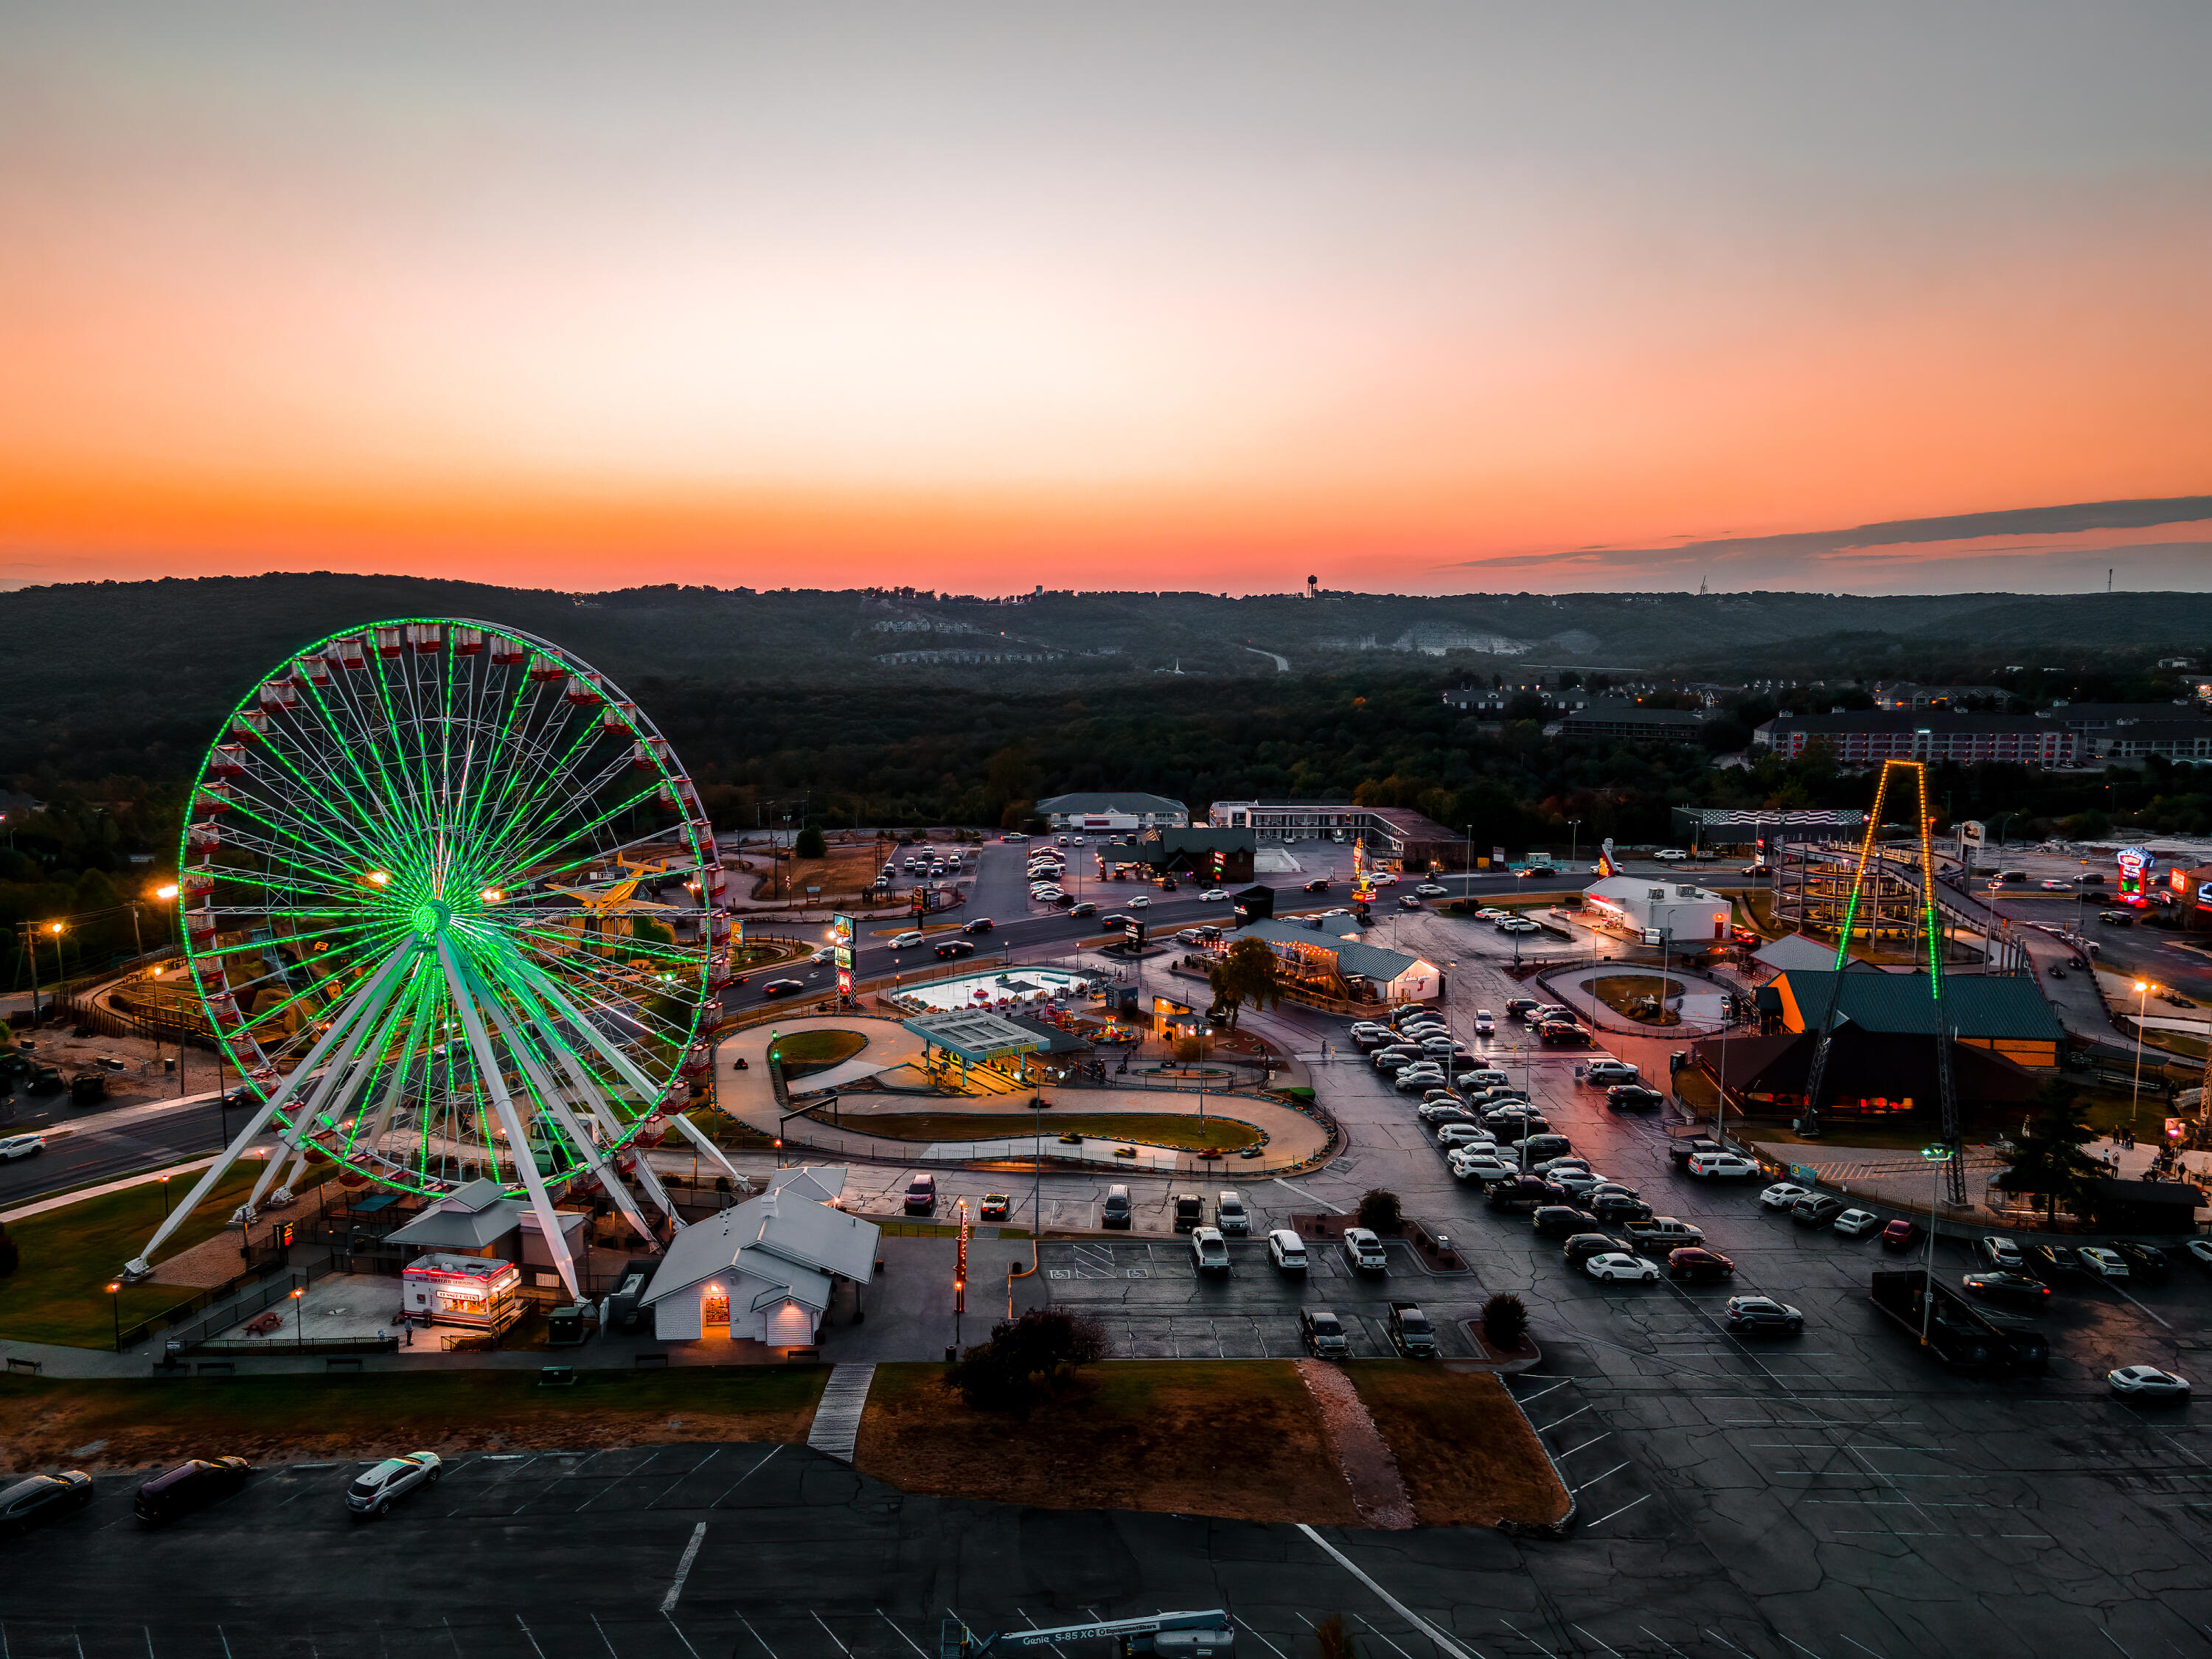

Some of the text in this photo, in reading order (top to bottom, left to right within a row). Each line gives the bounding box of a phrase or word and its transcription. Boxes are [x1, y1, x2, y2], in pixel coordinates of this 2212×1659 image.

[1023, 1636, 1050, 1646] Genie
[1055, 1632, 1078, 1642] S-85
[1080, 1630, 1095, 1640] XC
